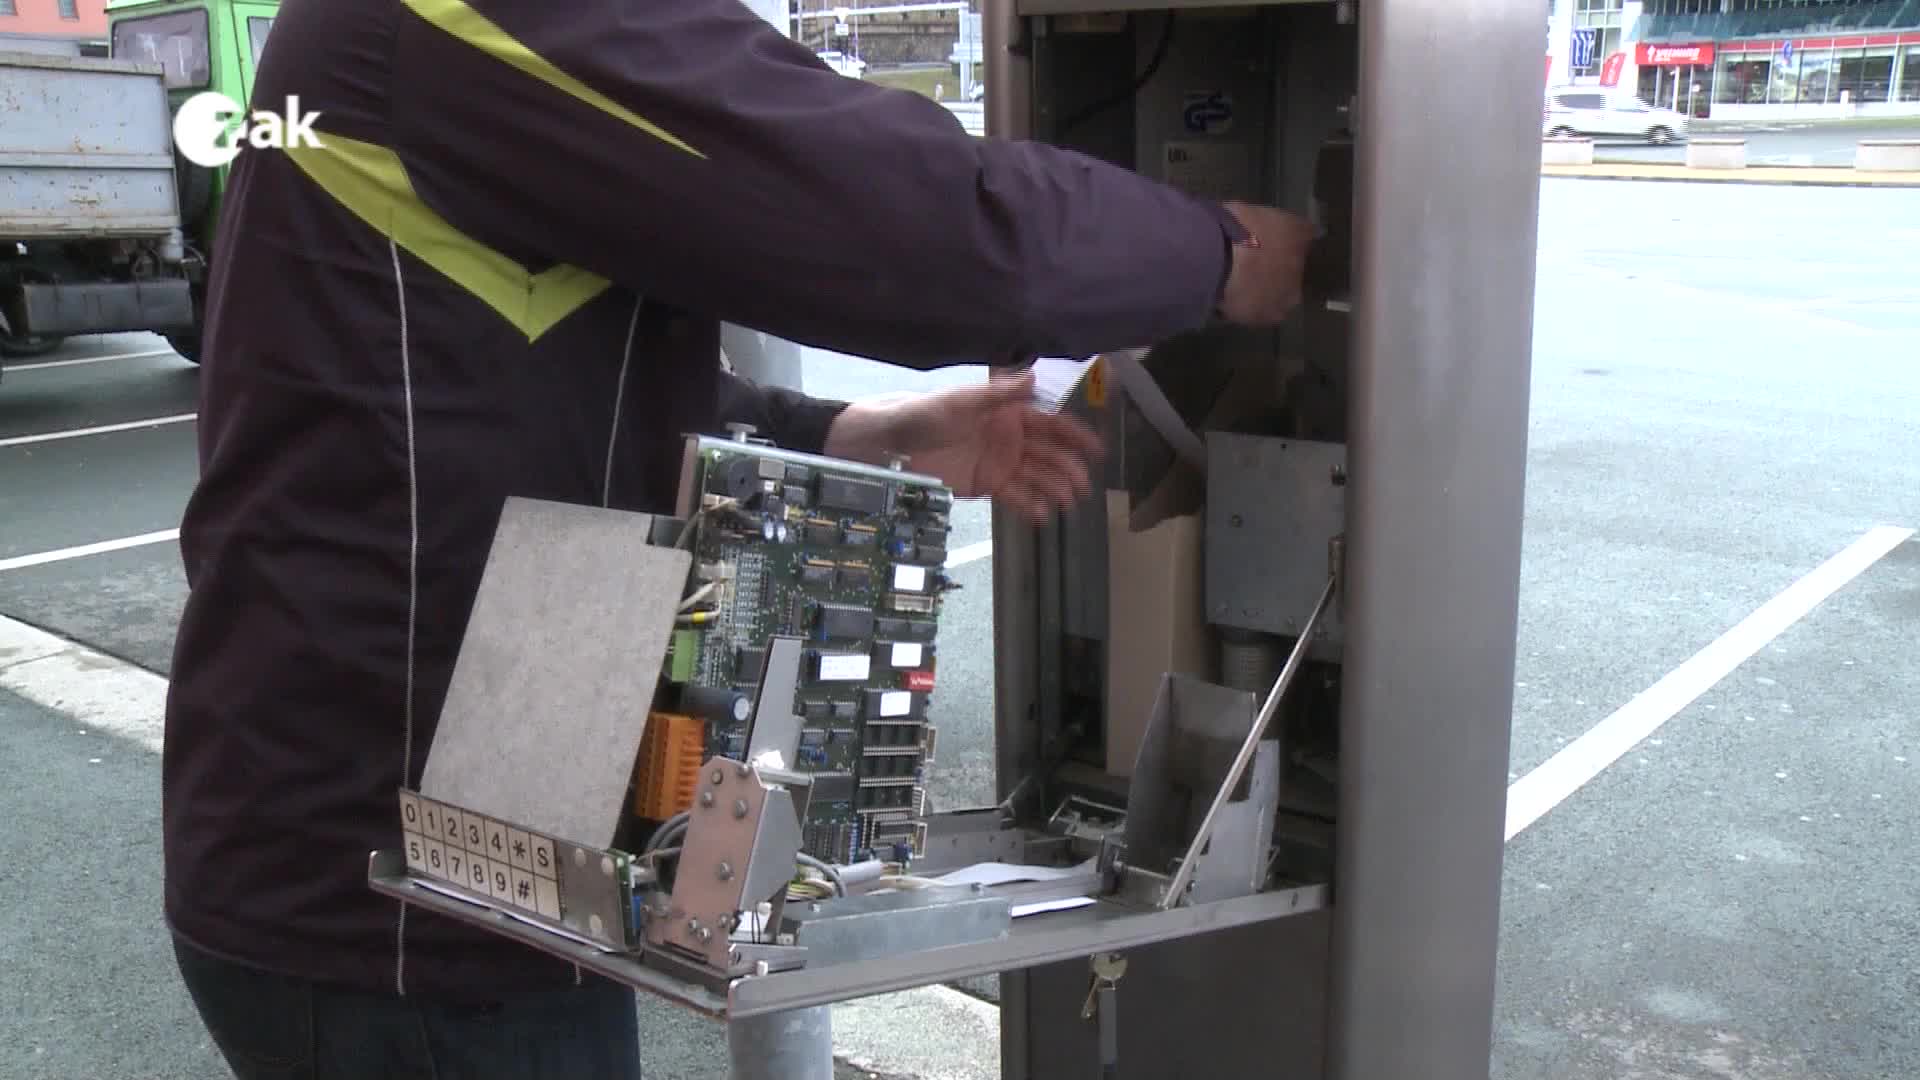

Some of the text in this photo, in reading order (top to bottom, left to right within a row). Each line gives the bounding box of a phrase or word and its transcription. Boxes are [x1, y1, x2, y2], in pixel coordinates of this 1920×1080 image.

[406, 804, 415, 822] 0
[428, 812, 434, 829] 1
[448, 818, 457, 837] 2
[469, 825, 479, 844] 3
[491, 833, 502, 852] 4
[537, 847, 549, 867] S
[410, 842, 530, 899] 5 6 7 8 9 #
